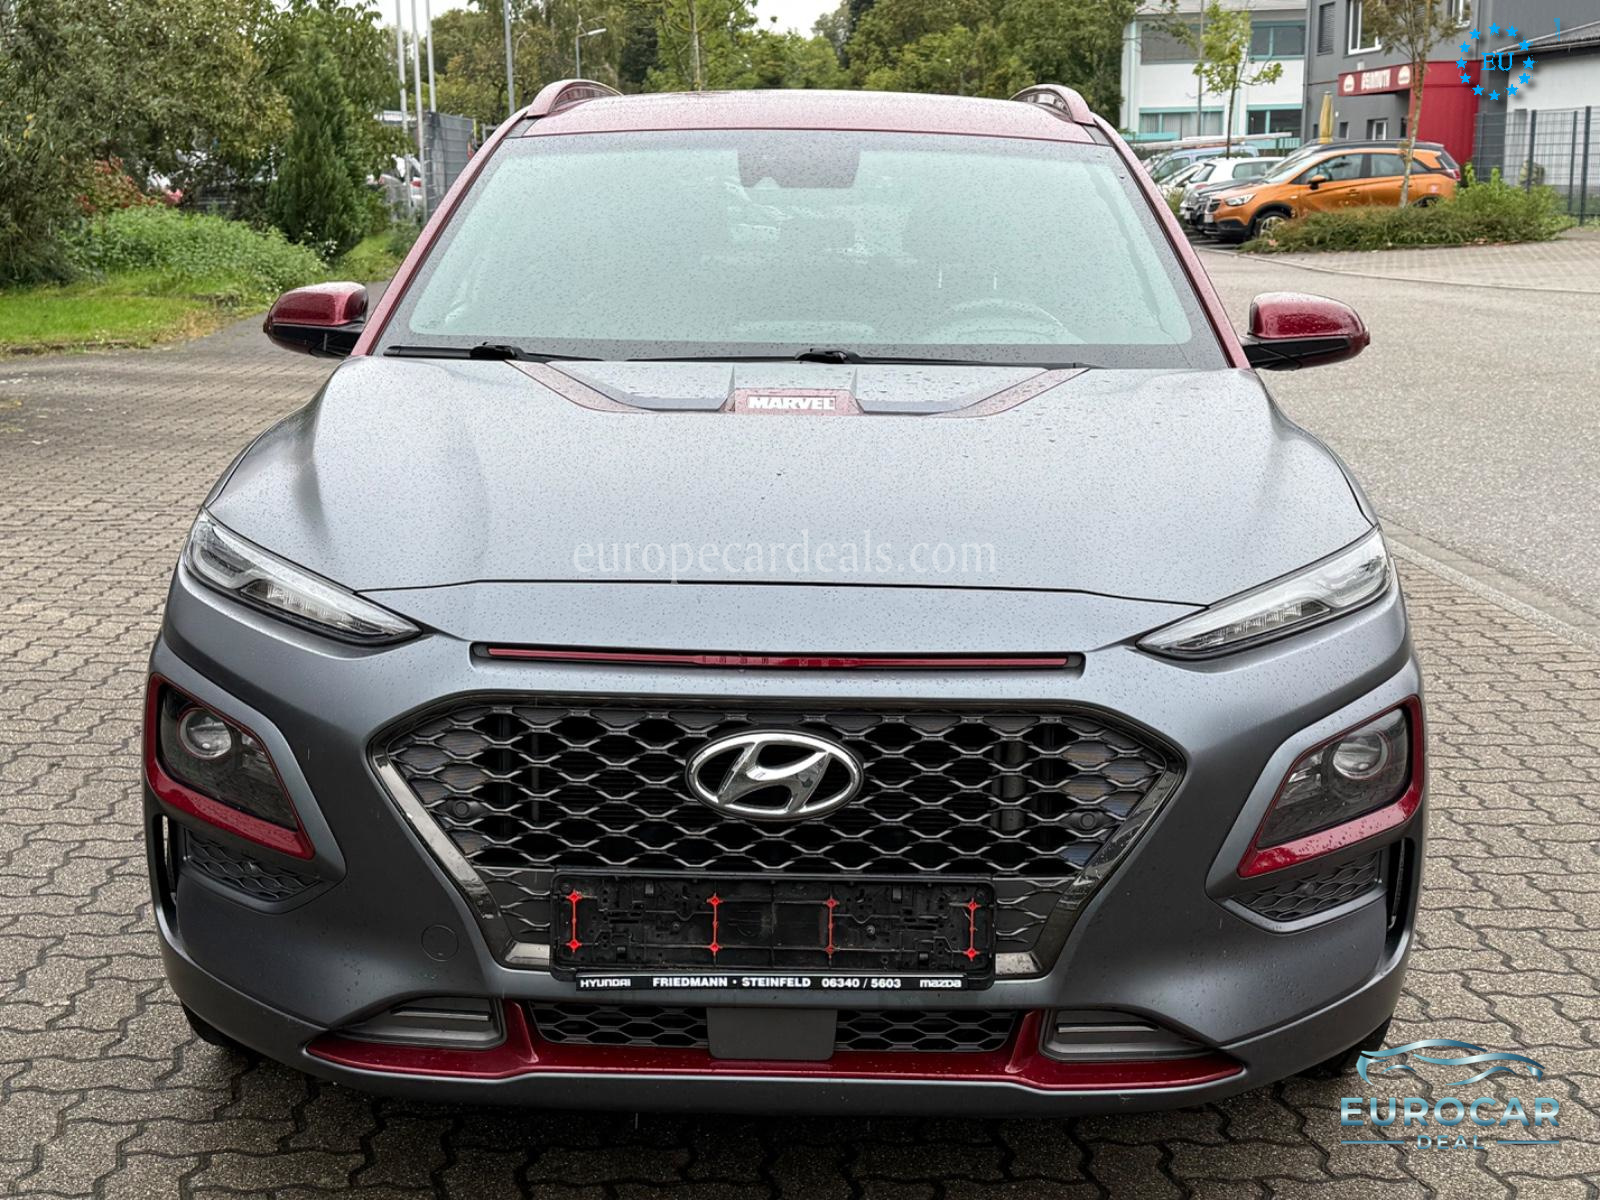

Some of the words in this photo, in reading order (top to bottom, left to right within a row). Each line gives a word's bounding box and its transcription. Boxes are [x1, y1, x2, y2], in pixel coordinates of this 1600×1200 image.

[747, 397, 836, 410] MARVEL
[580, 978, 632, 988] HYUNDAI
[652, 977, 729, 988] FRIEDMANN
[741, 977, 812, 988] STEINFELD
[821, 978, 861, 988] 06340
[870, 978, 902, 989] 5603
